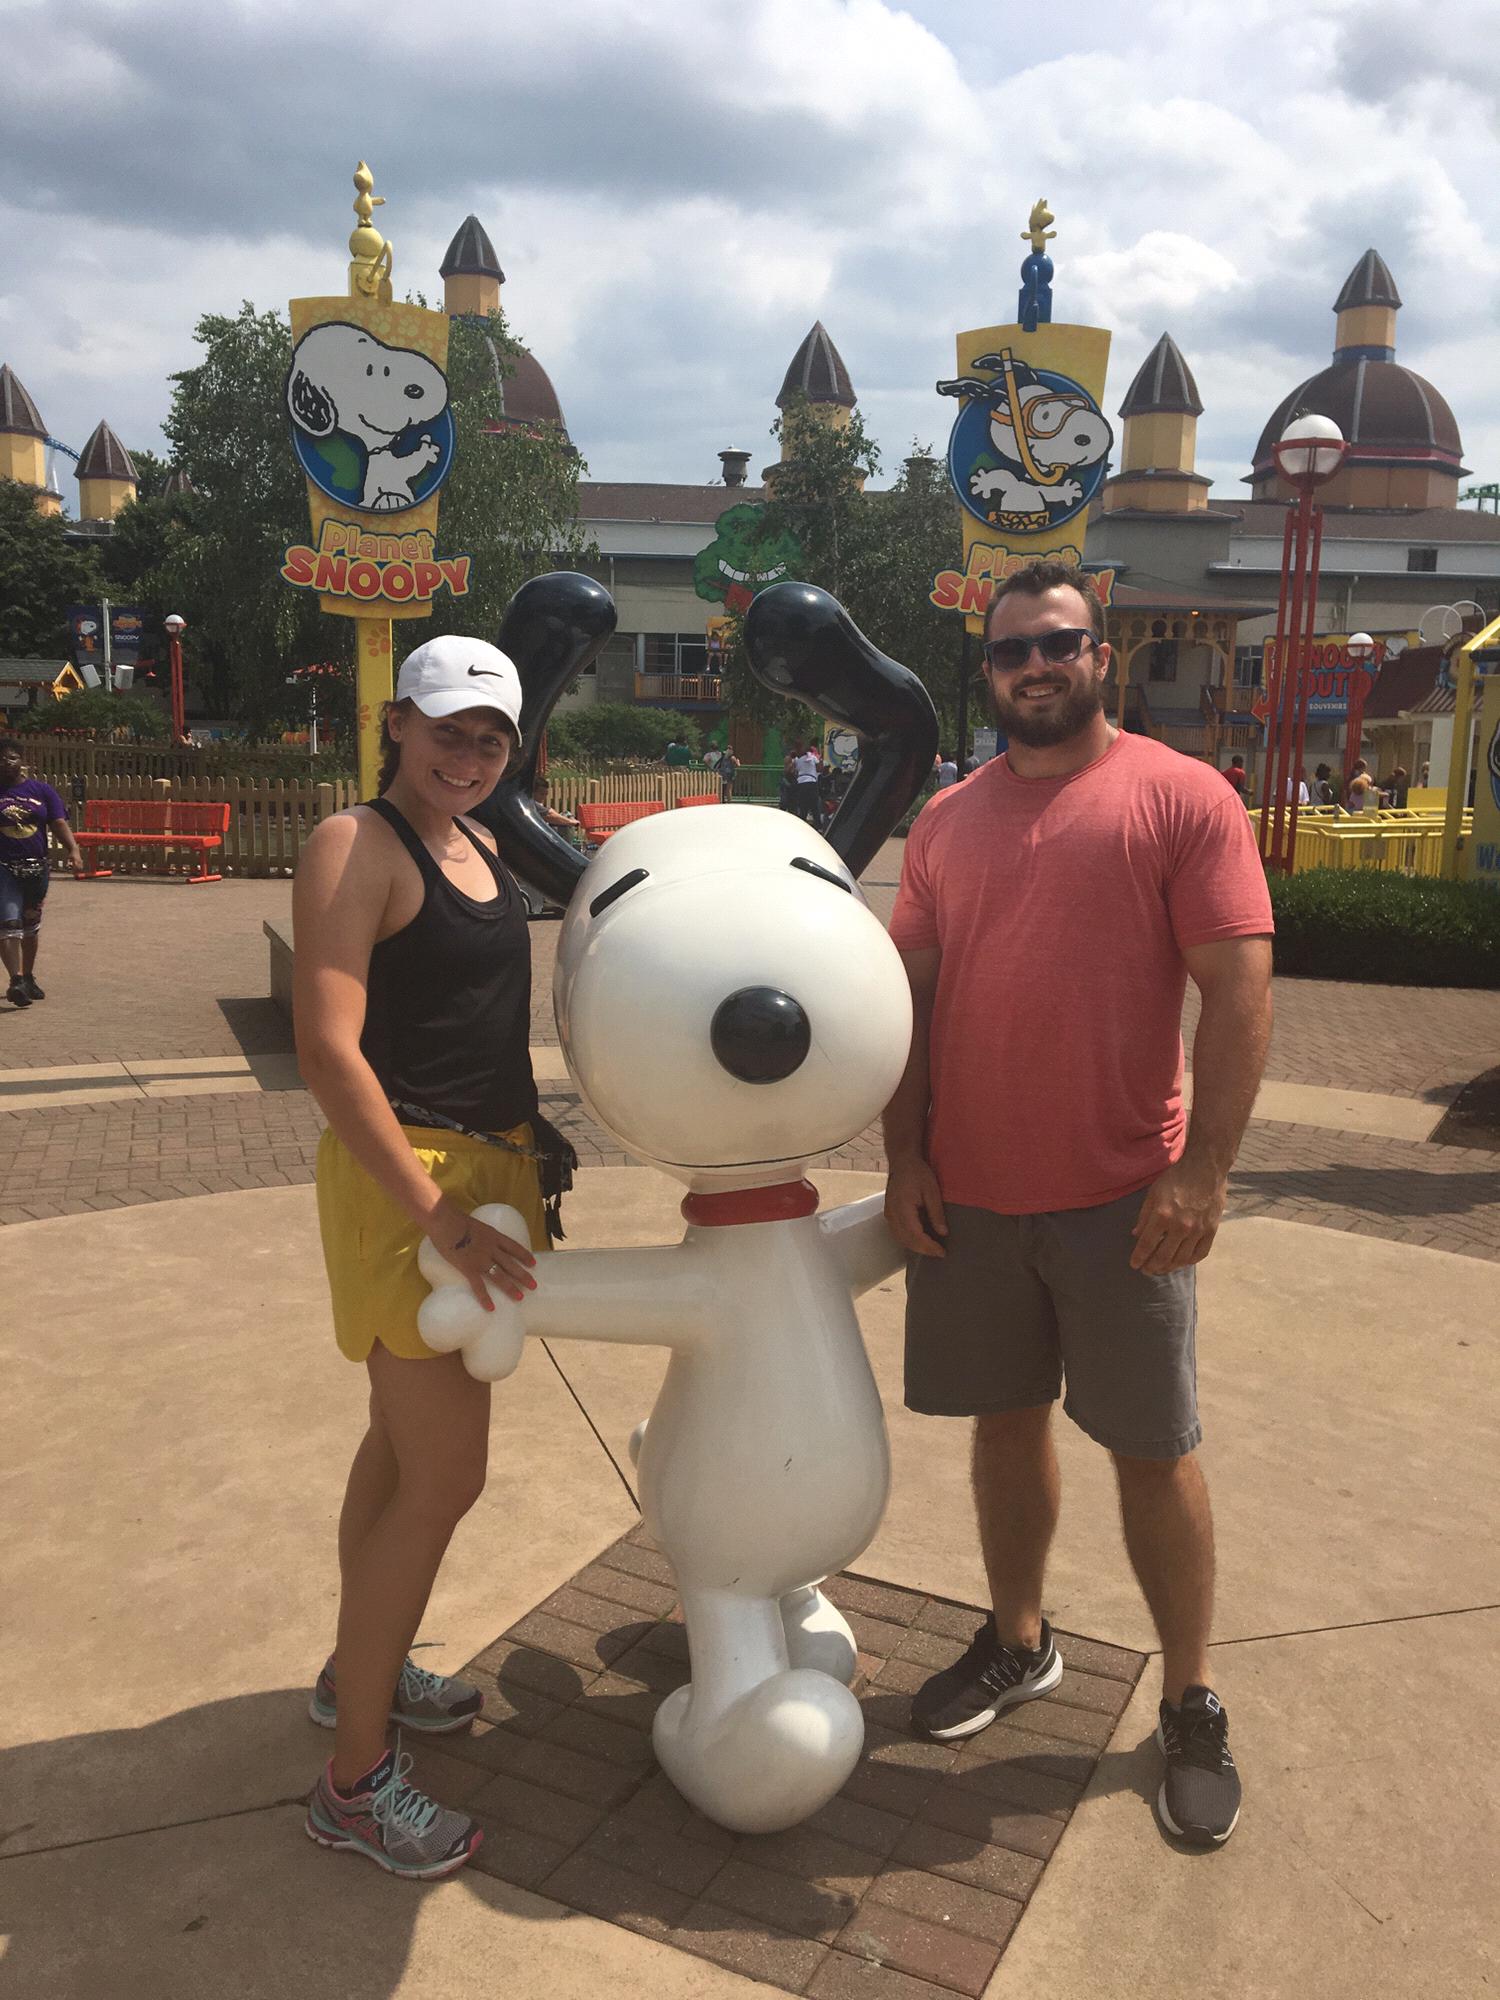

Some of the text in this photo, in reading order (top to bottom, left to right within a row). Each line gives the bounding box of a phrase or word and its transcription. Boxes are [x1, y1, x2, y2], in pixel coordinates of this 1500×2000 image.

[322, 522, 434, 560] Planet
[281, 546, 470, 600] SNOOPY
[968, 547, 1079, 578] Plat
[930, 570, 1115, 614] SNY
